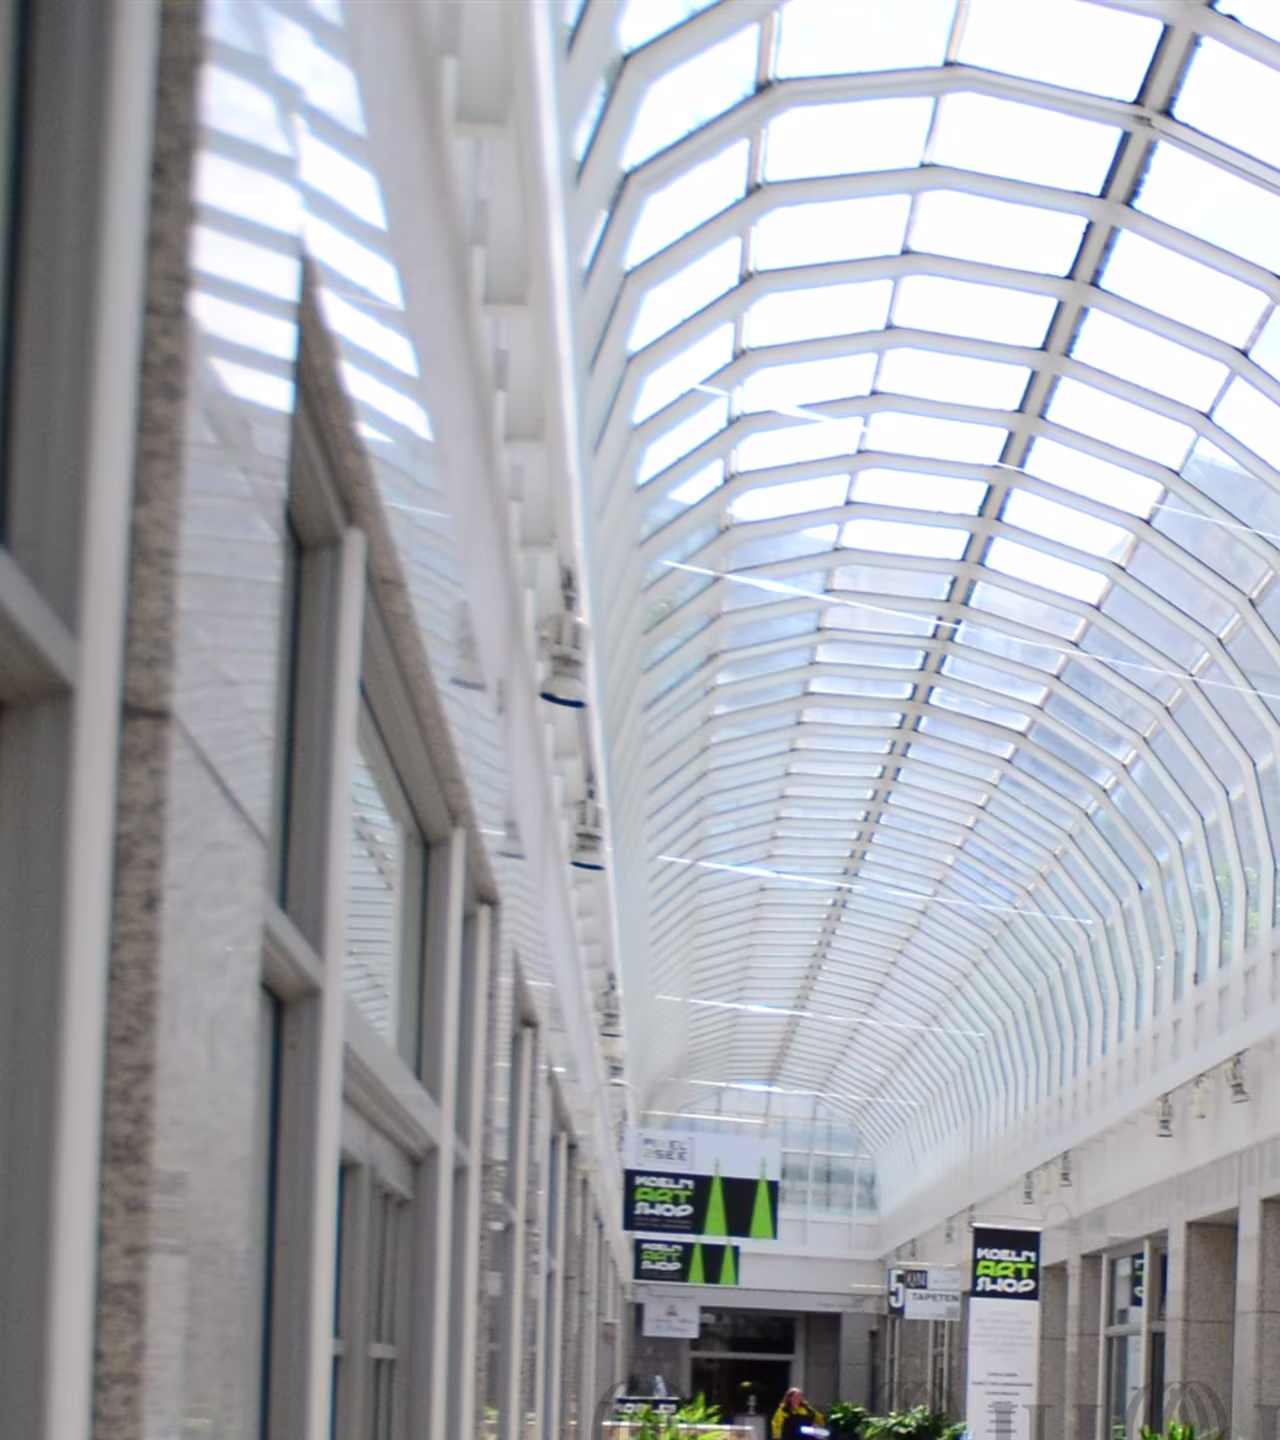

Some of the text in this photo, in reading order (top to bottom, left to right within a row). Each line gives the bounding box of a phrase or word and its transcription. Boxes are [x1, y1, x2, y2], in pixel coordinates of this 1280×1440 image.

[634, 1187, 694, 1204] ART
[634, 1202, 695, 1217] SHOP
[641, 1251, 682, 1262] ART
[976, 1260, 1035, 1278] ART
[890, 1269, 903, 1308] 5
[976, 1276, 1036, 1293] SHOP
